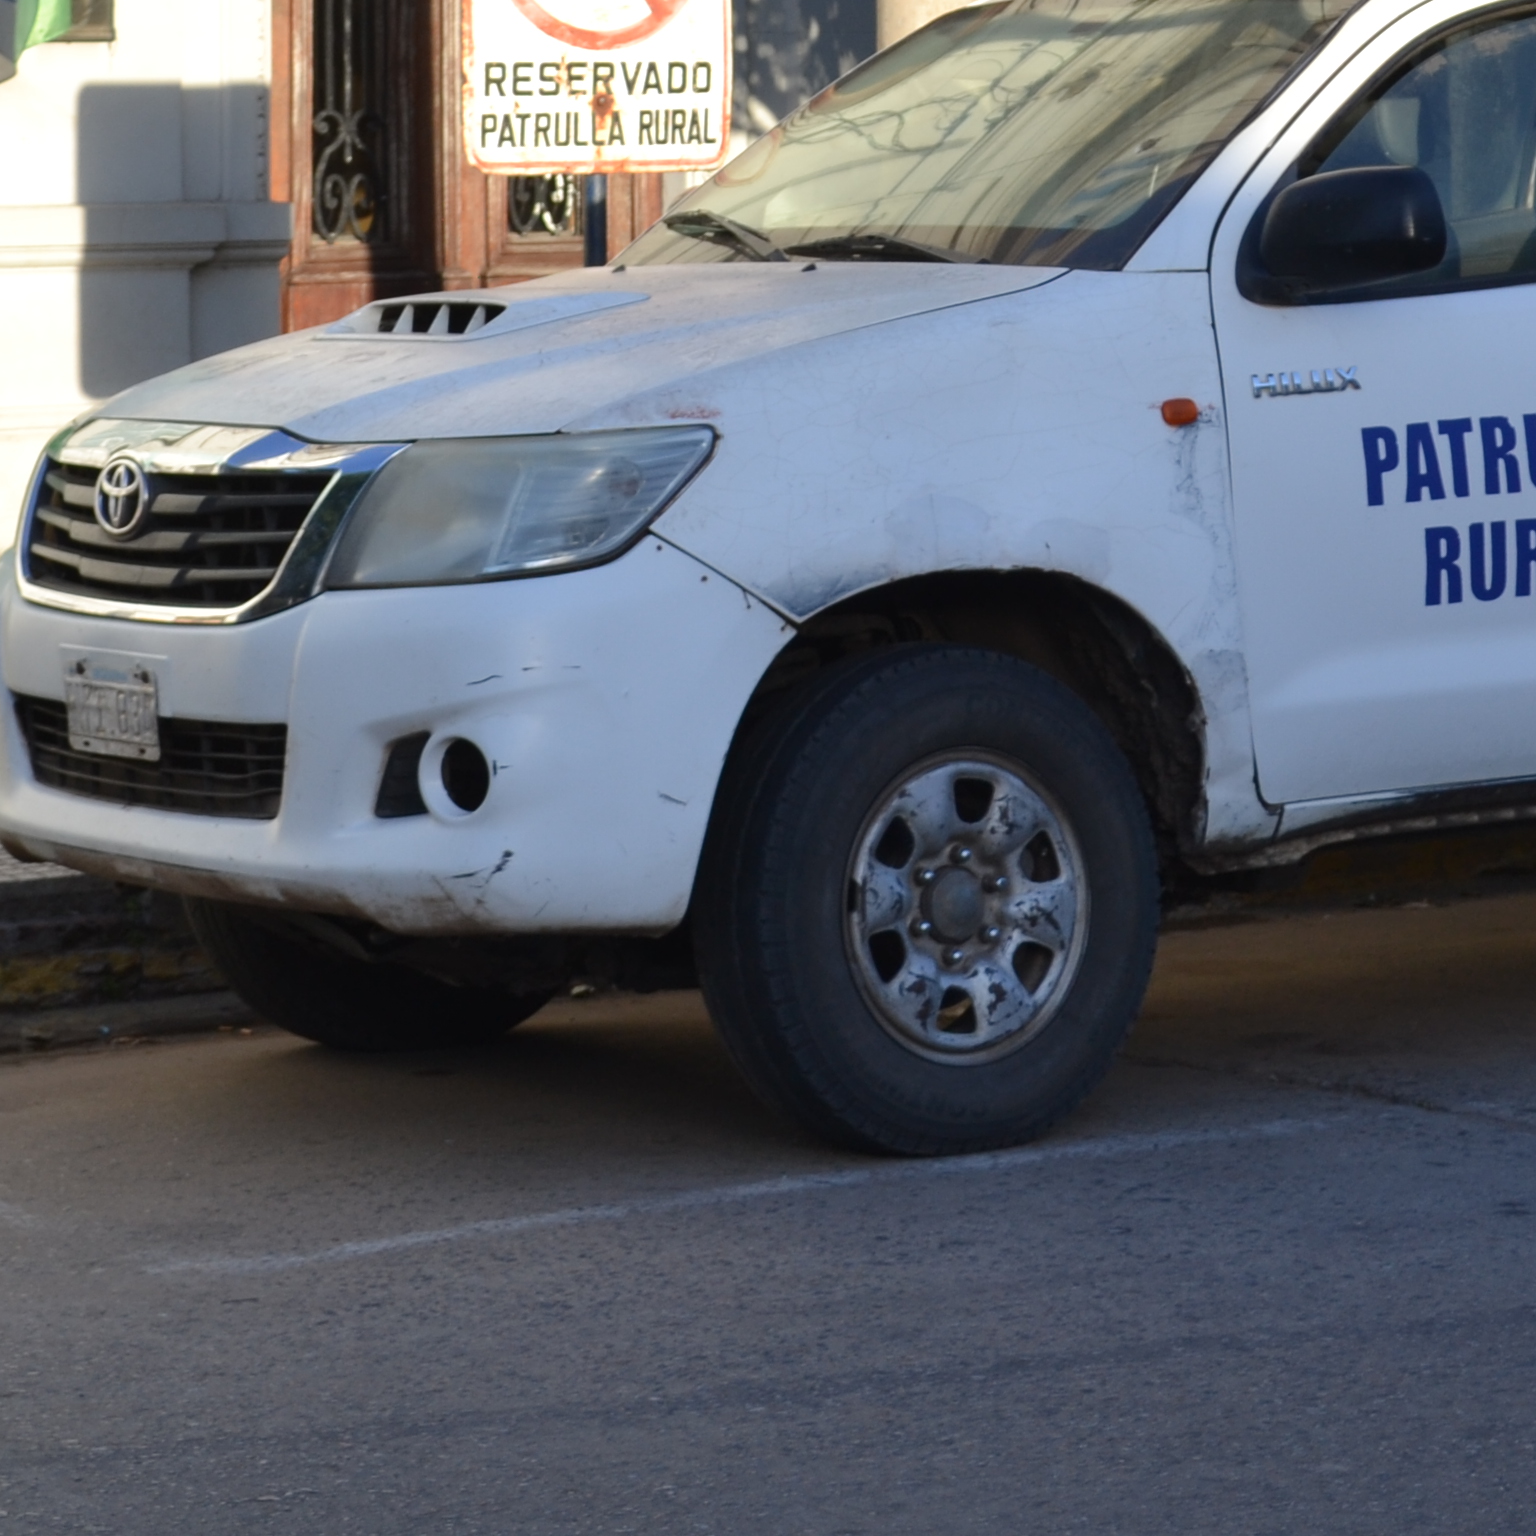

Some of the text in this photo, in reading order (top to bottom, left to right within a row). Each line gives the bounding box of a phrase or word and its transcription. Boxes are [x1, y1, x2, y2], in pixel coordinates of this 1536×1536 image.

[484, 61, 712, 96] RESERVADO
[481, 108, 717, 148] PATRULLA RURAL
[1251, 365, 1362, 398] HILUX
